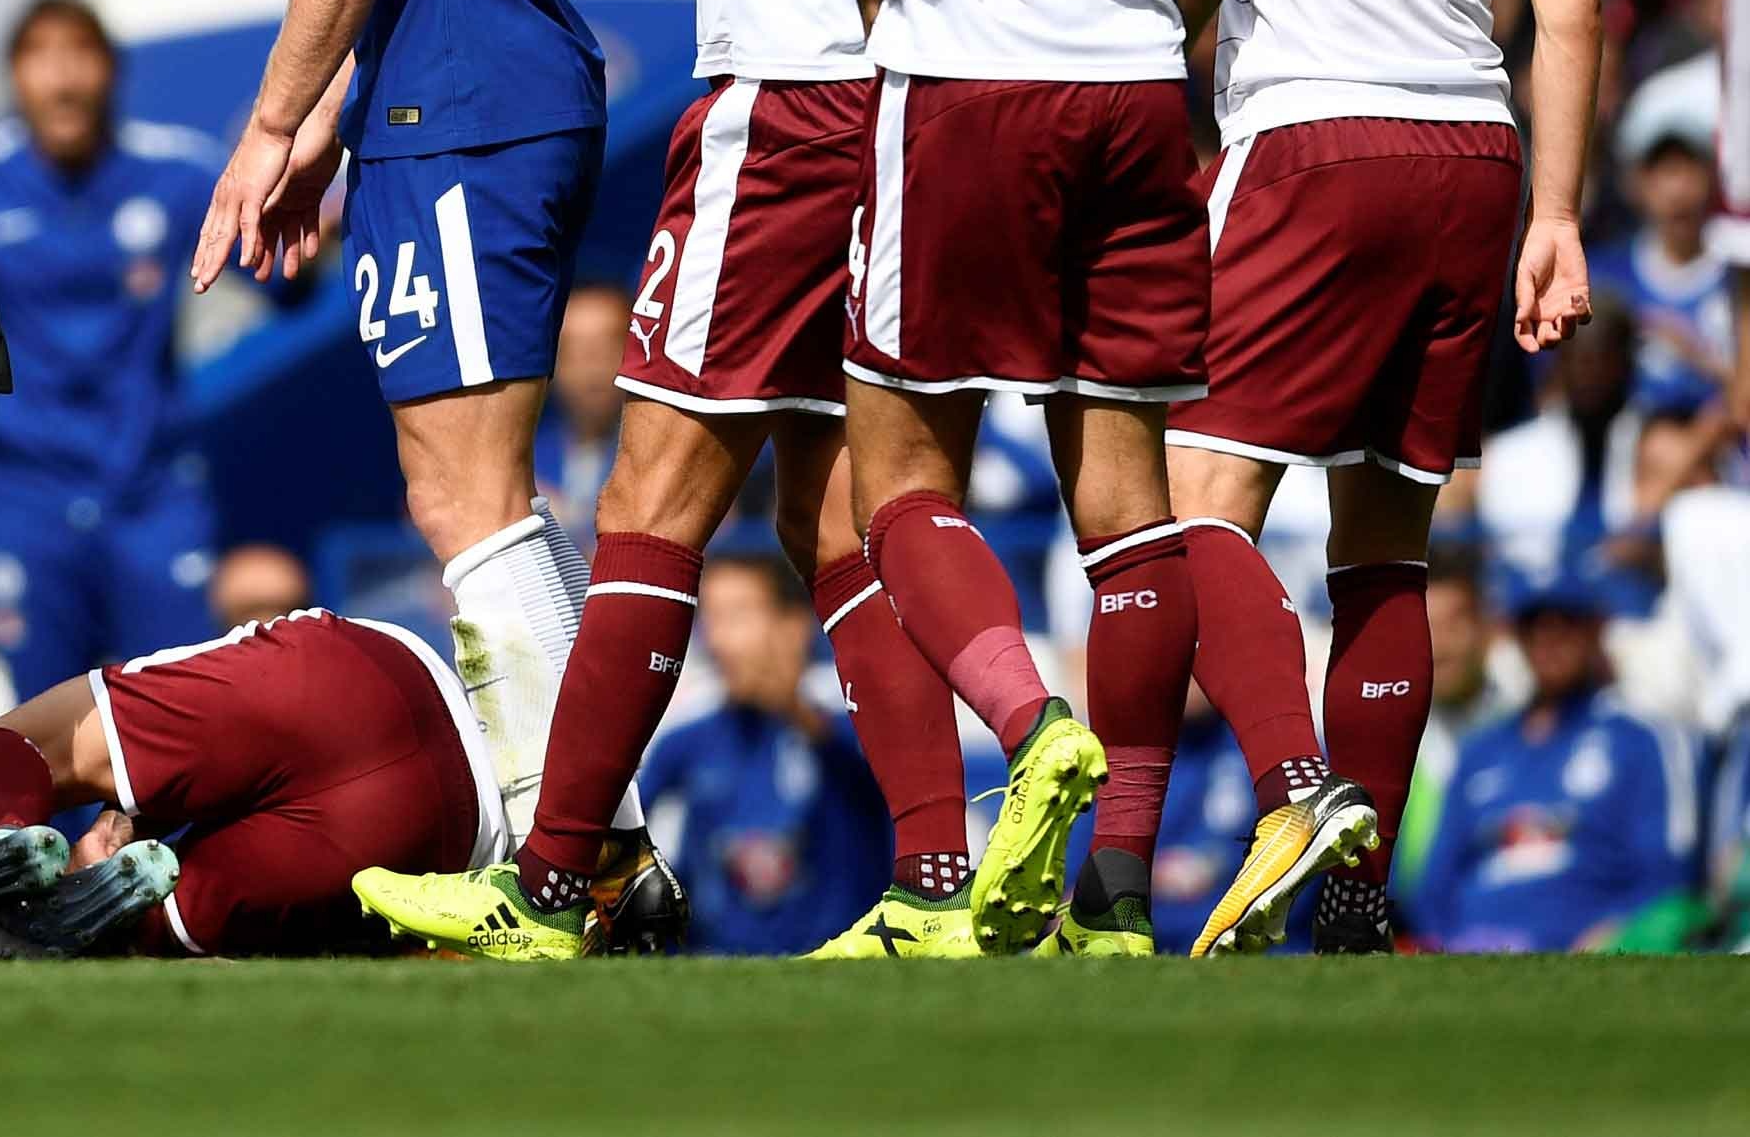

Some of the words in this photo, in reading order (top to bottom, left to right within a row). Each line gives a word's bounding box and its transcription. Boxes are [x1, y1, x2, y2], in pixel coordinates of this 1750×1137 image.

[631, 228, 676, 320] 2
[354, 240, 439, 343] 24
[1100, 589, 1158, 614] BFC
[1361, 680, 1410, 699] BFC
[467, 928, 533, 946] adidas
